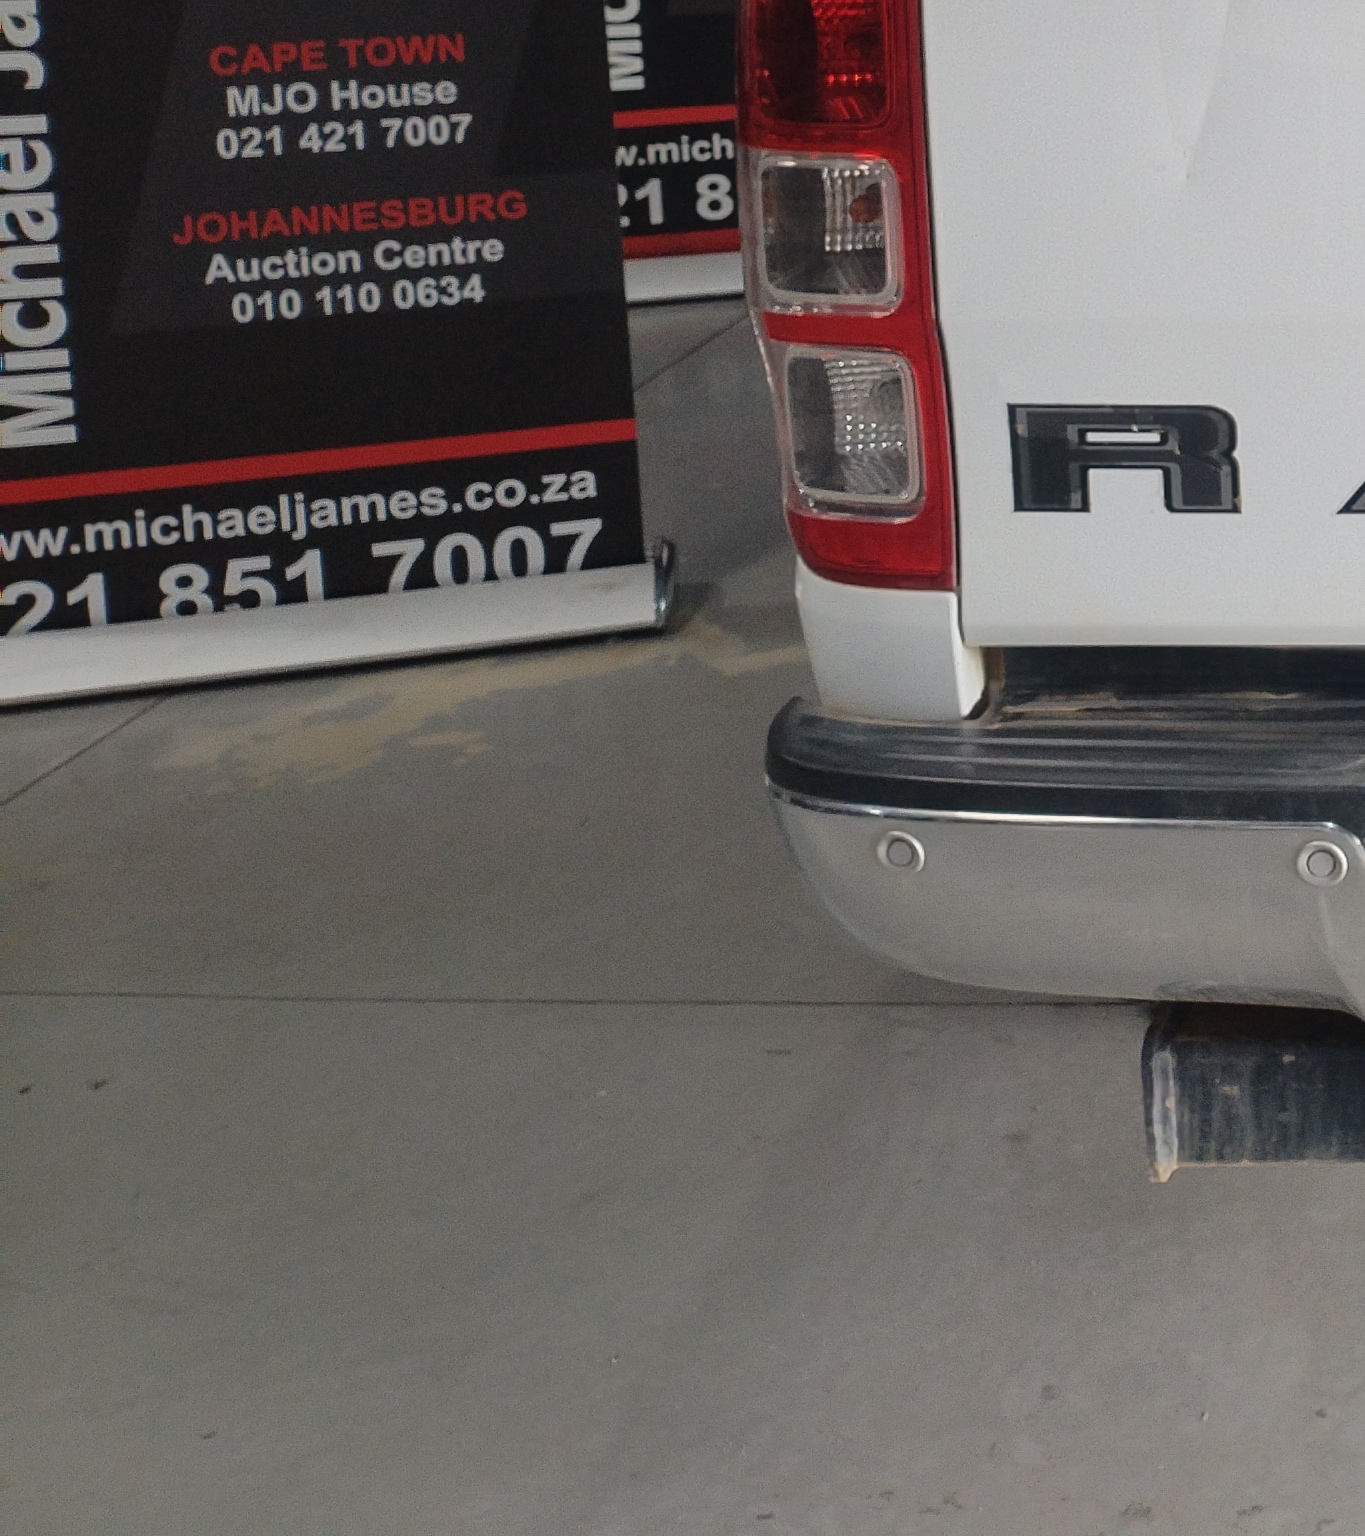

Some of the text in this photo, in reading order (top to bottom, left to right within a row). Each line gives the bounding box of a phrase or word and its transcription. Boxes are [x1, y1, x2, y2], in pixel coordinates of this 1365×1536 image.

[210, 34, 464, 75] CAPE TOWN
[227, 80, 457, 117] MJO House
[217, 113, 472, 159] 021 421 7007
[173, 190, 527, 245] JOHANNESBURG
[0, 114, 77, 448] Michael
[205, 237, 504, 284] Auction Centre
[232, 274, 485, 323] 010 110 0634
[371, 517, 603, 592] 7007
